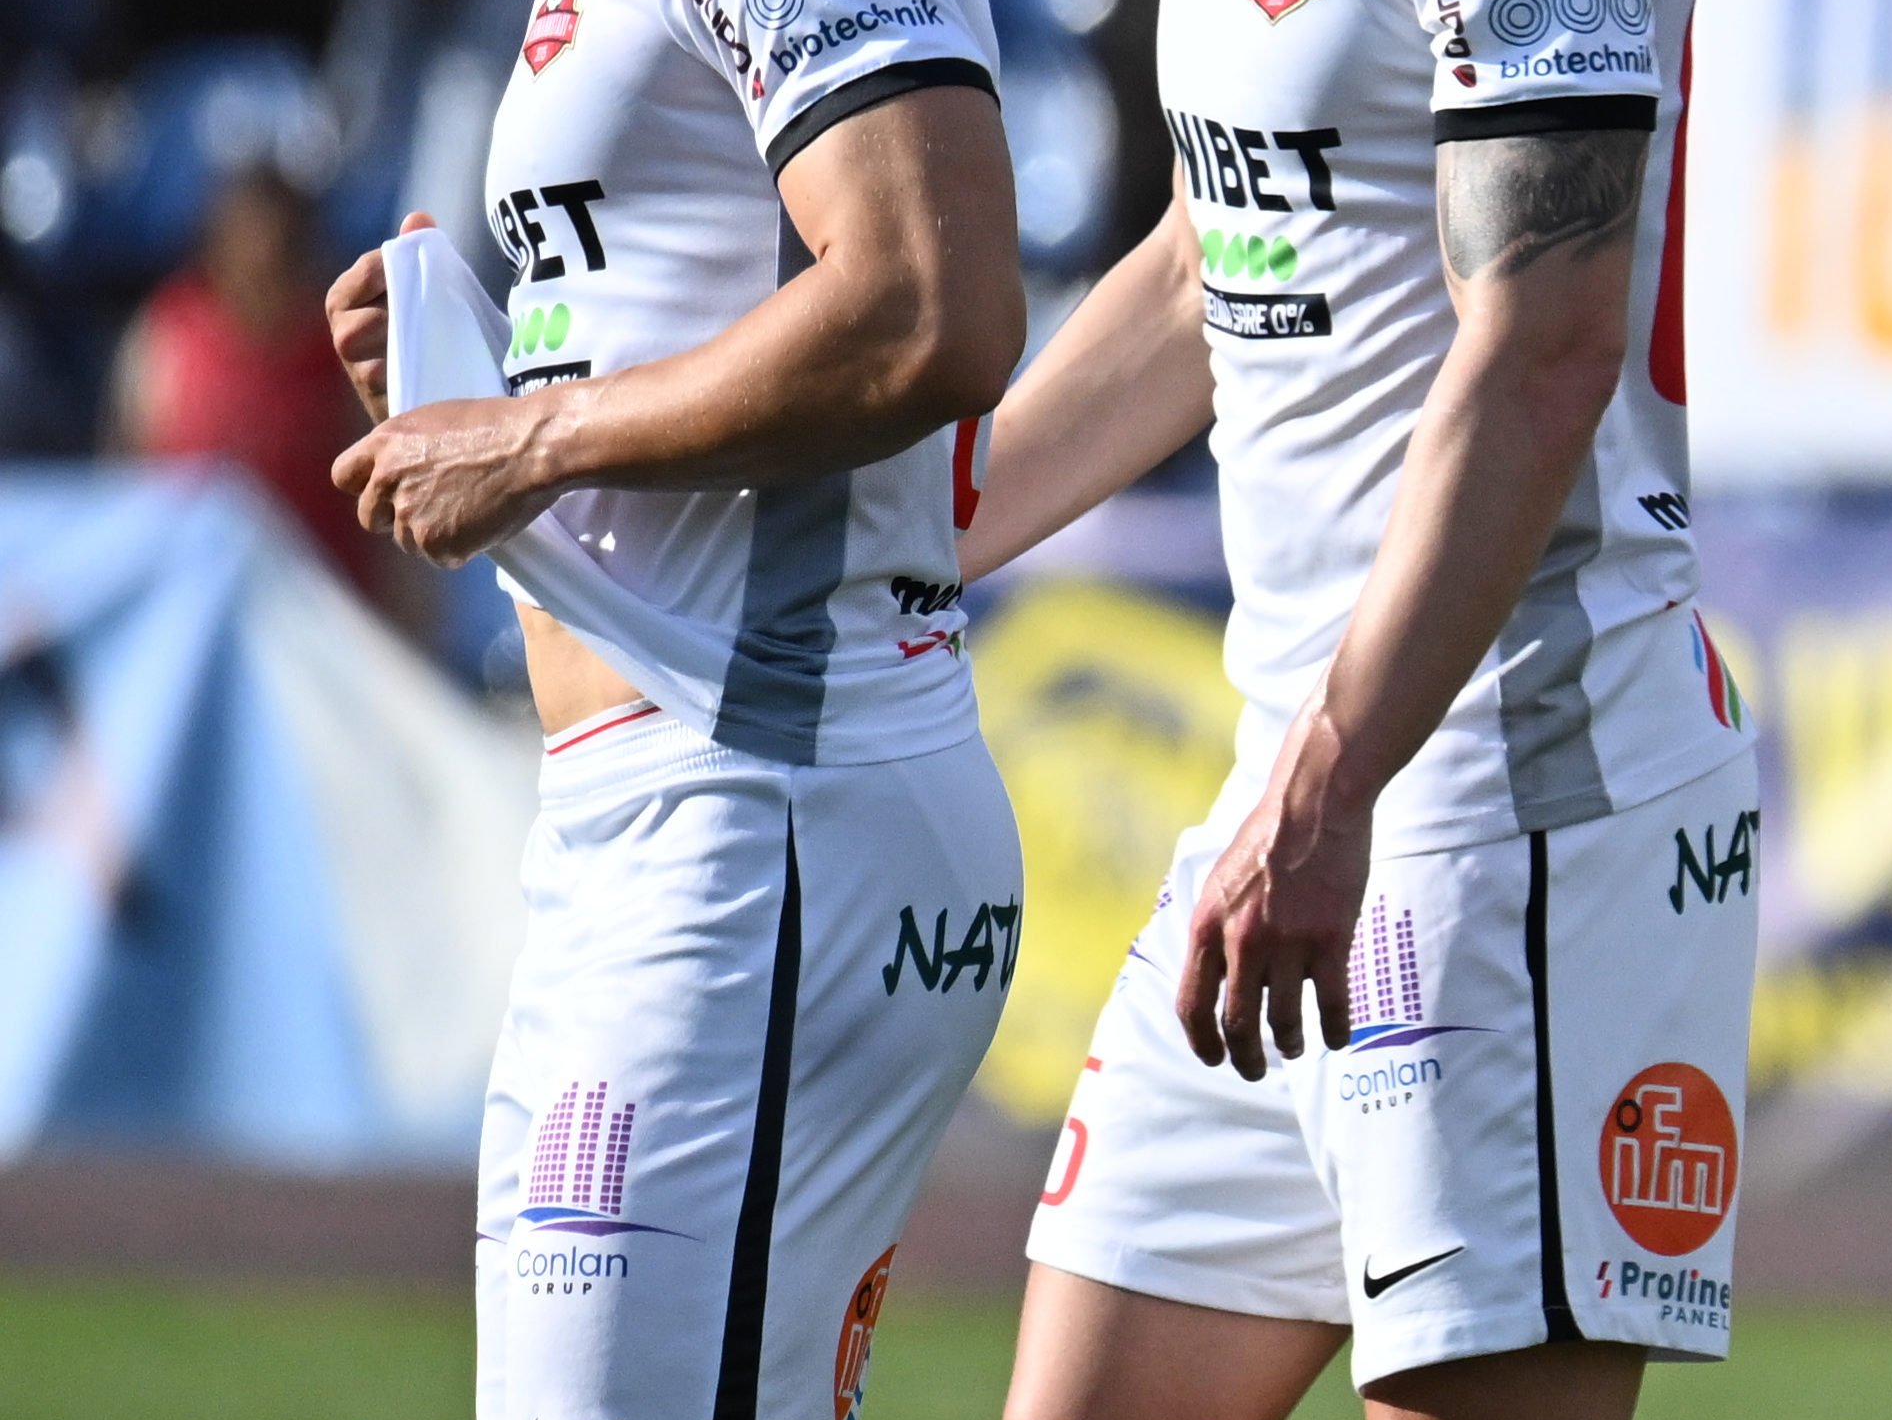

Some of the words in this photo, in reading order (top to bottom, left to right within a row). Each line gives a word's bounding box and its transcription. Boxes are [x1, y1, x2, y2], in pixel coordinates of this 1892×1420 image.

[1270, 303, 1315, 335] 0%
[881, 892, 1023, 997] NAT
[1339, 1058, 1443, 1102] Conlan
[1361, 1091, 1414, 1115] GRUP
[1612, 1083, 1725, 1216] ifm
[516, 1245, 628, 1279] Conlan
[531, 1282, 593, 1296] GRUP
[1620, 1260, 1731, 1310] Proline
